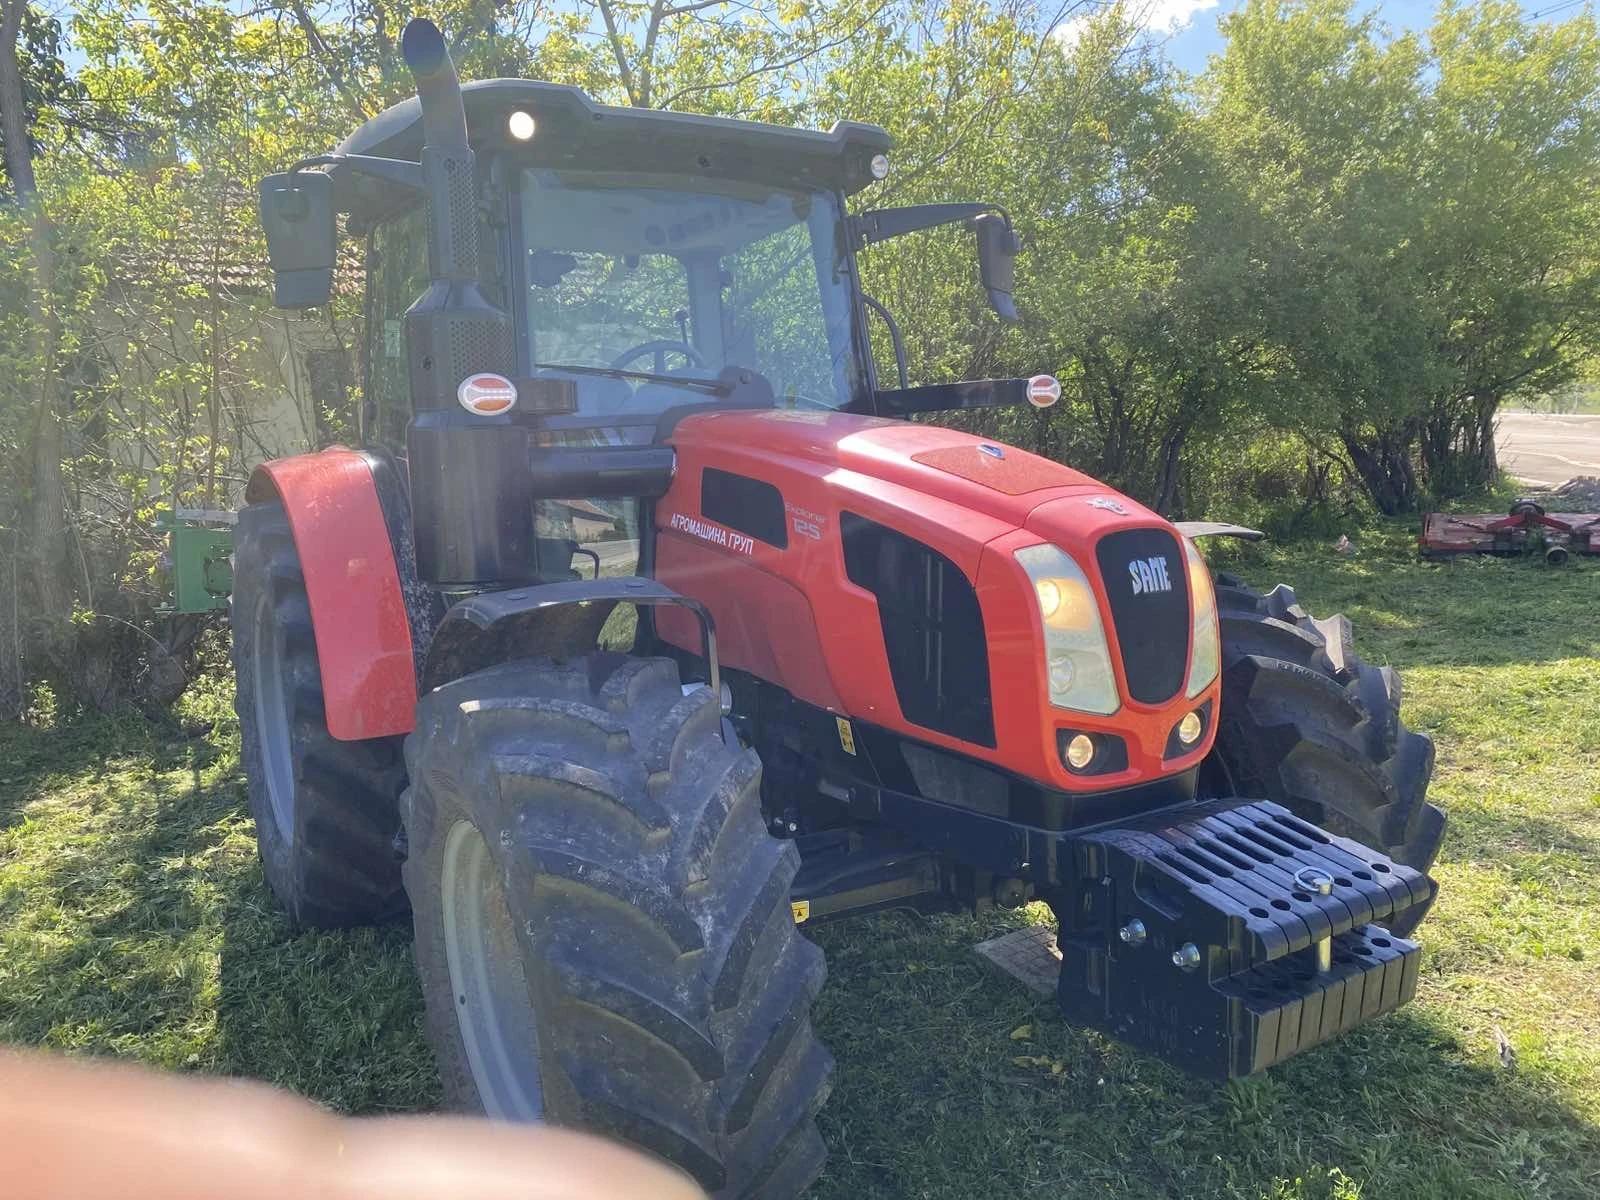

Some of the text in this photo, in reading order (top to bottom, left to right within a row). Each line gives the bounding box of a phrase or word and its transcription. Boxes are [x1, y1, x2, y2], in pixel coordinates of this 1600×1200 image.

[671, 514, 754, 555] АГРОМАШИНА ГРУП
[792, 517, 821, 540] 125
[1128, 556, 1171, 595] SAME
